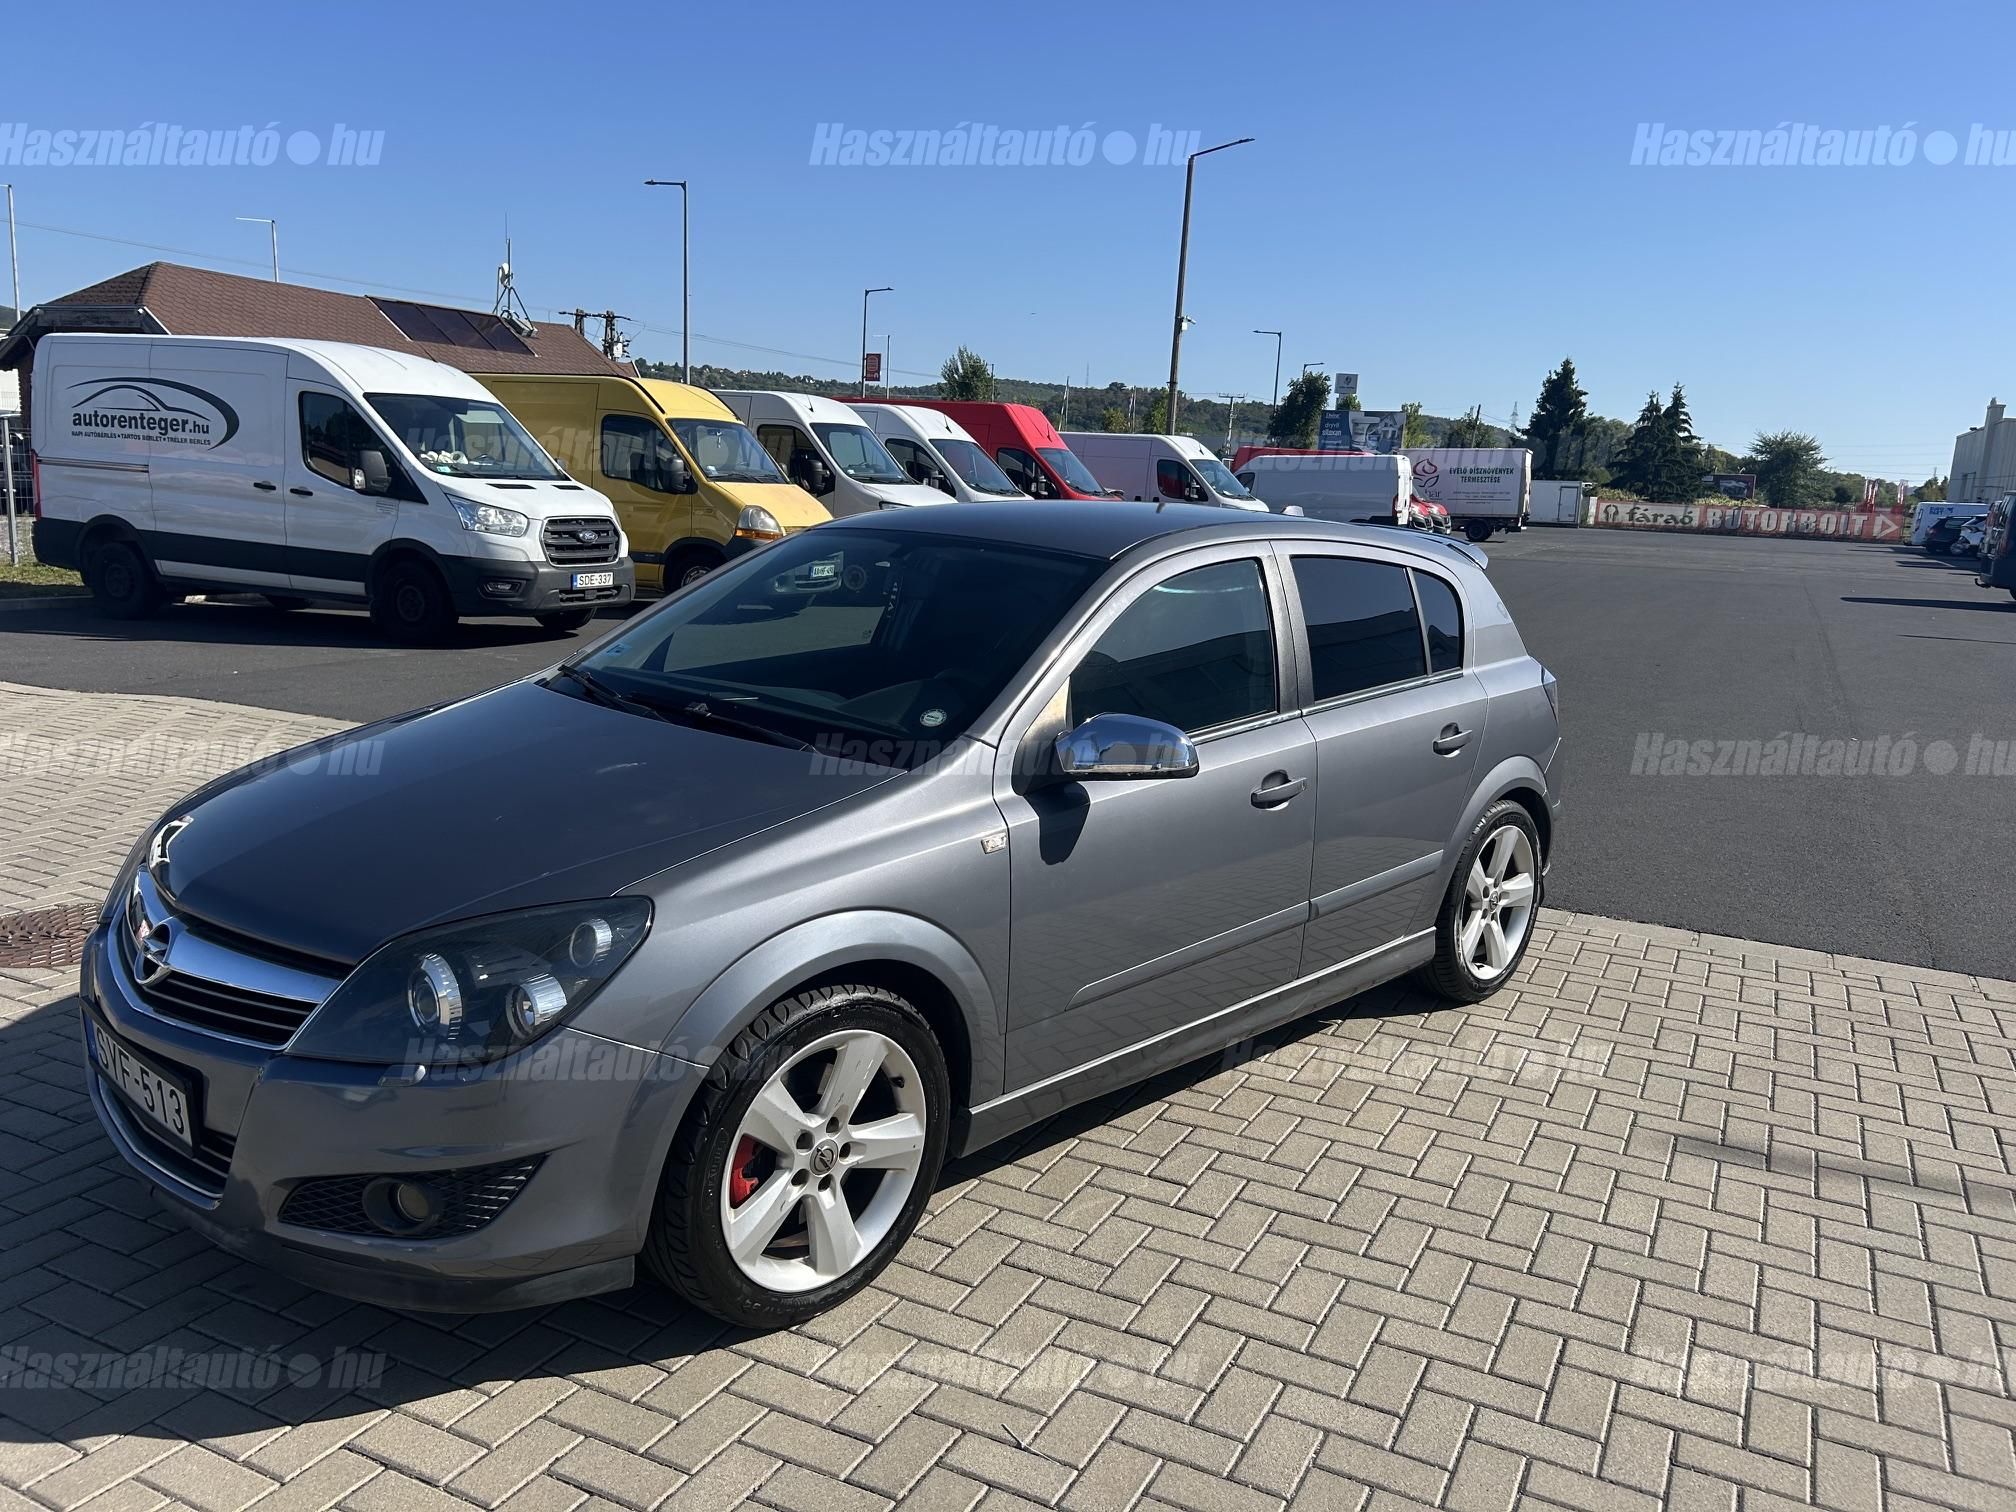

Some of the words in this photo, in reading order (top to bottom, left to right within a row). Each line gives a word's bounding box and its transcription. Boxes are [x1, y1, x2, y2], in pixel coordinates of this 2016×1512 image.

[72, 410, 210, 436] autorenteger.hu
[1626, 506, 1693, 526] fáraó
[1706, 507, 1869, 537] BÚTORBOLT
[578, 574, 612, 586] SDE-337
[96, 1027, 185, 1135] SYF-513
